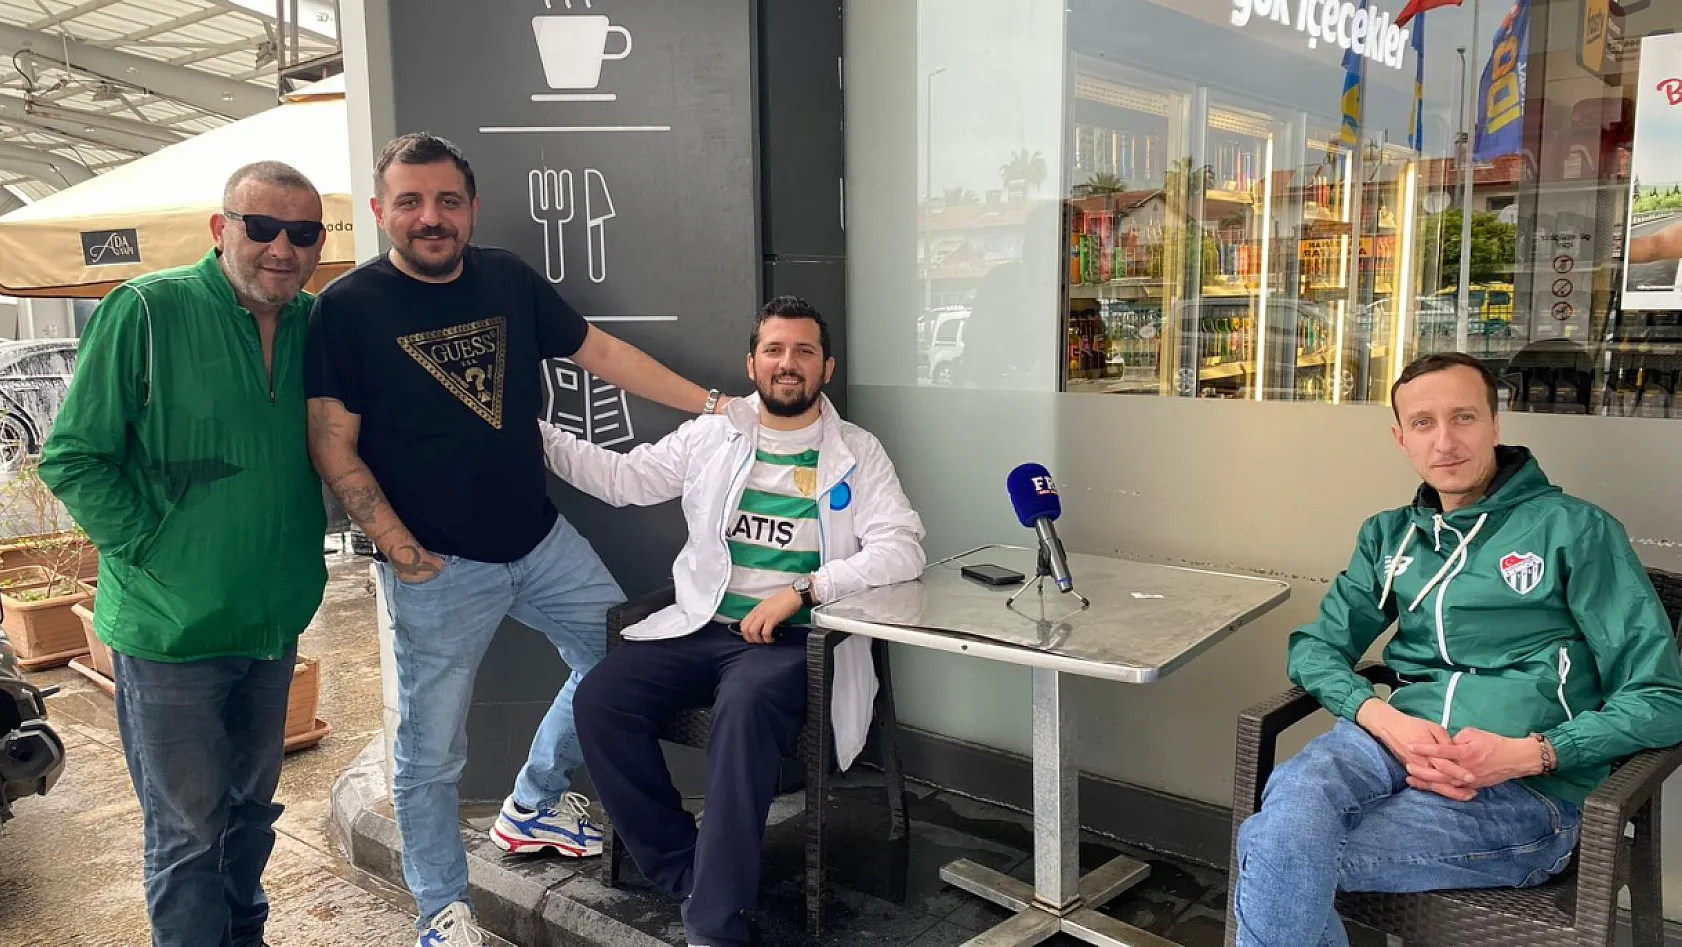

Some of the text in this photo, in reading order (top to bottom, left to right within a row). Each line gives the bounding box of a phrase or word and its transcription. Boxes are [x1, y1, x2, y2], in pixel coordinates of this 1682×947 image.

[1296, 0, 1409, 69] içecekler
[430, 333, 496, 364] GUESS
[725, 514, 795, 548] ATIŞ
